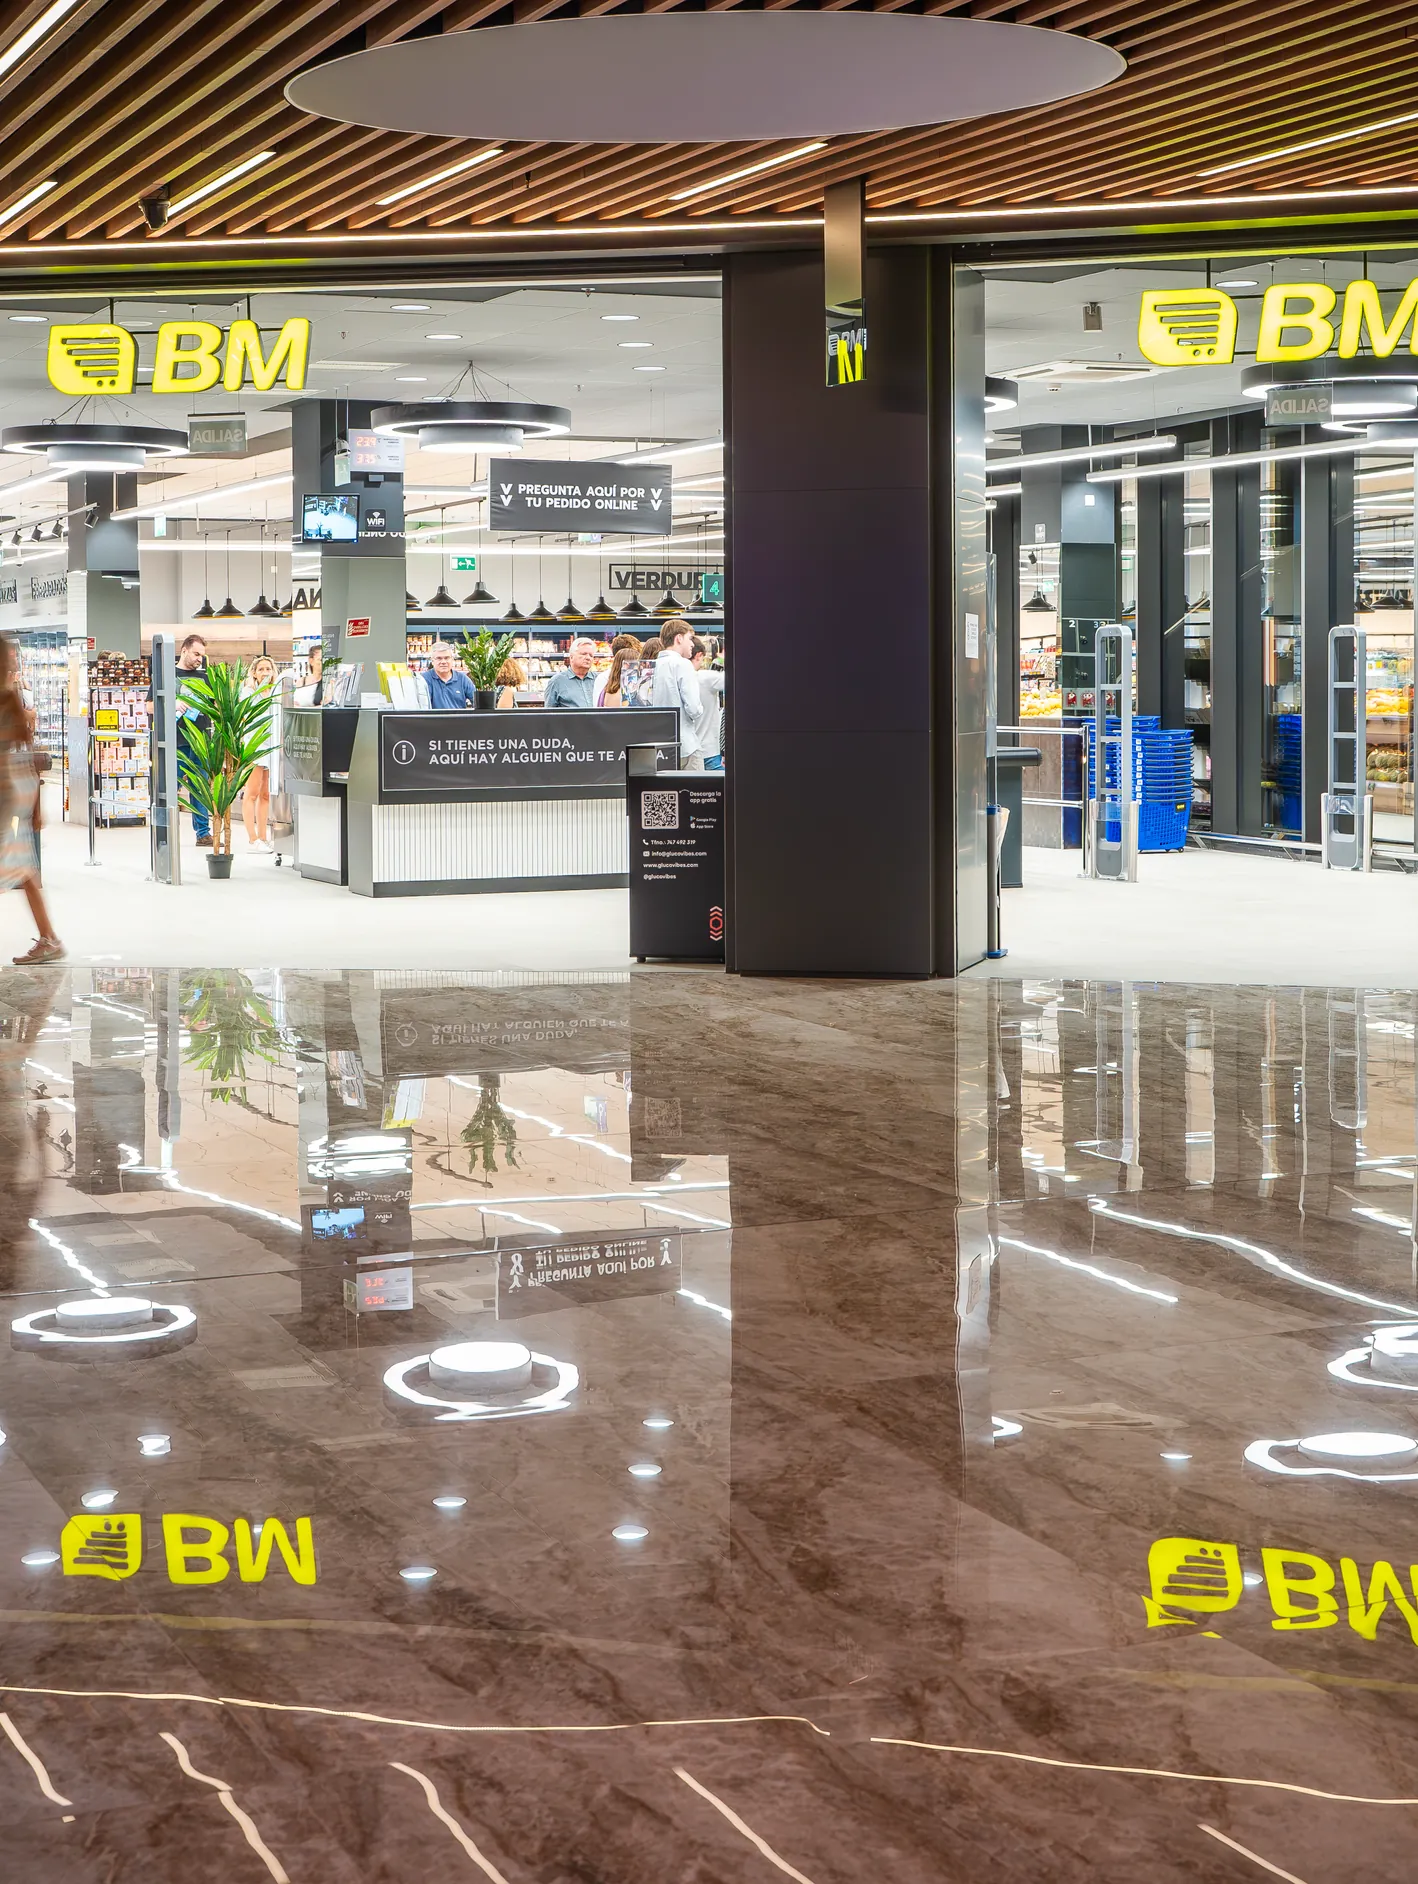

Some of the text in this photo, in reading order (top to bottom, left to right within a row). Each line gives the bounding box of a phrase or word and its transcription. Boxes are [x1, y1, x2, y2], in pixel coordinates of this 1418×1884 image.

[1256, 277, 1418, 362] BM
[152, 317, 311, 393] BM
[518, 484, 645, 498] PREGUNTA AQUÍ POR
[525, 497, 638, 510] TU PEDIDO ONLINE
[615, 571, 703, 589] VERDUR
[709, 581, 720, 596] 4
[1069, 620, 1076, 628] 2
[429, 738, 575, 750] SI TIENES UNA DUDA,
[429, 751, 464, 764] AQUÍ
[469, 753, 498, 764] HAY
[502, 752, 561, 763] ALGUIEN
[566, 751, 594, 762] QUE
[598, 751, 614, 761] TE
